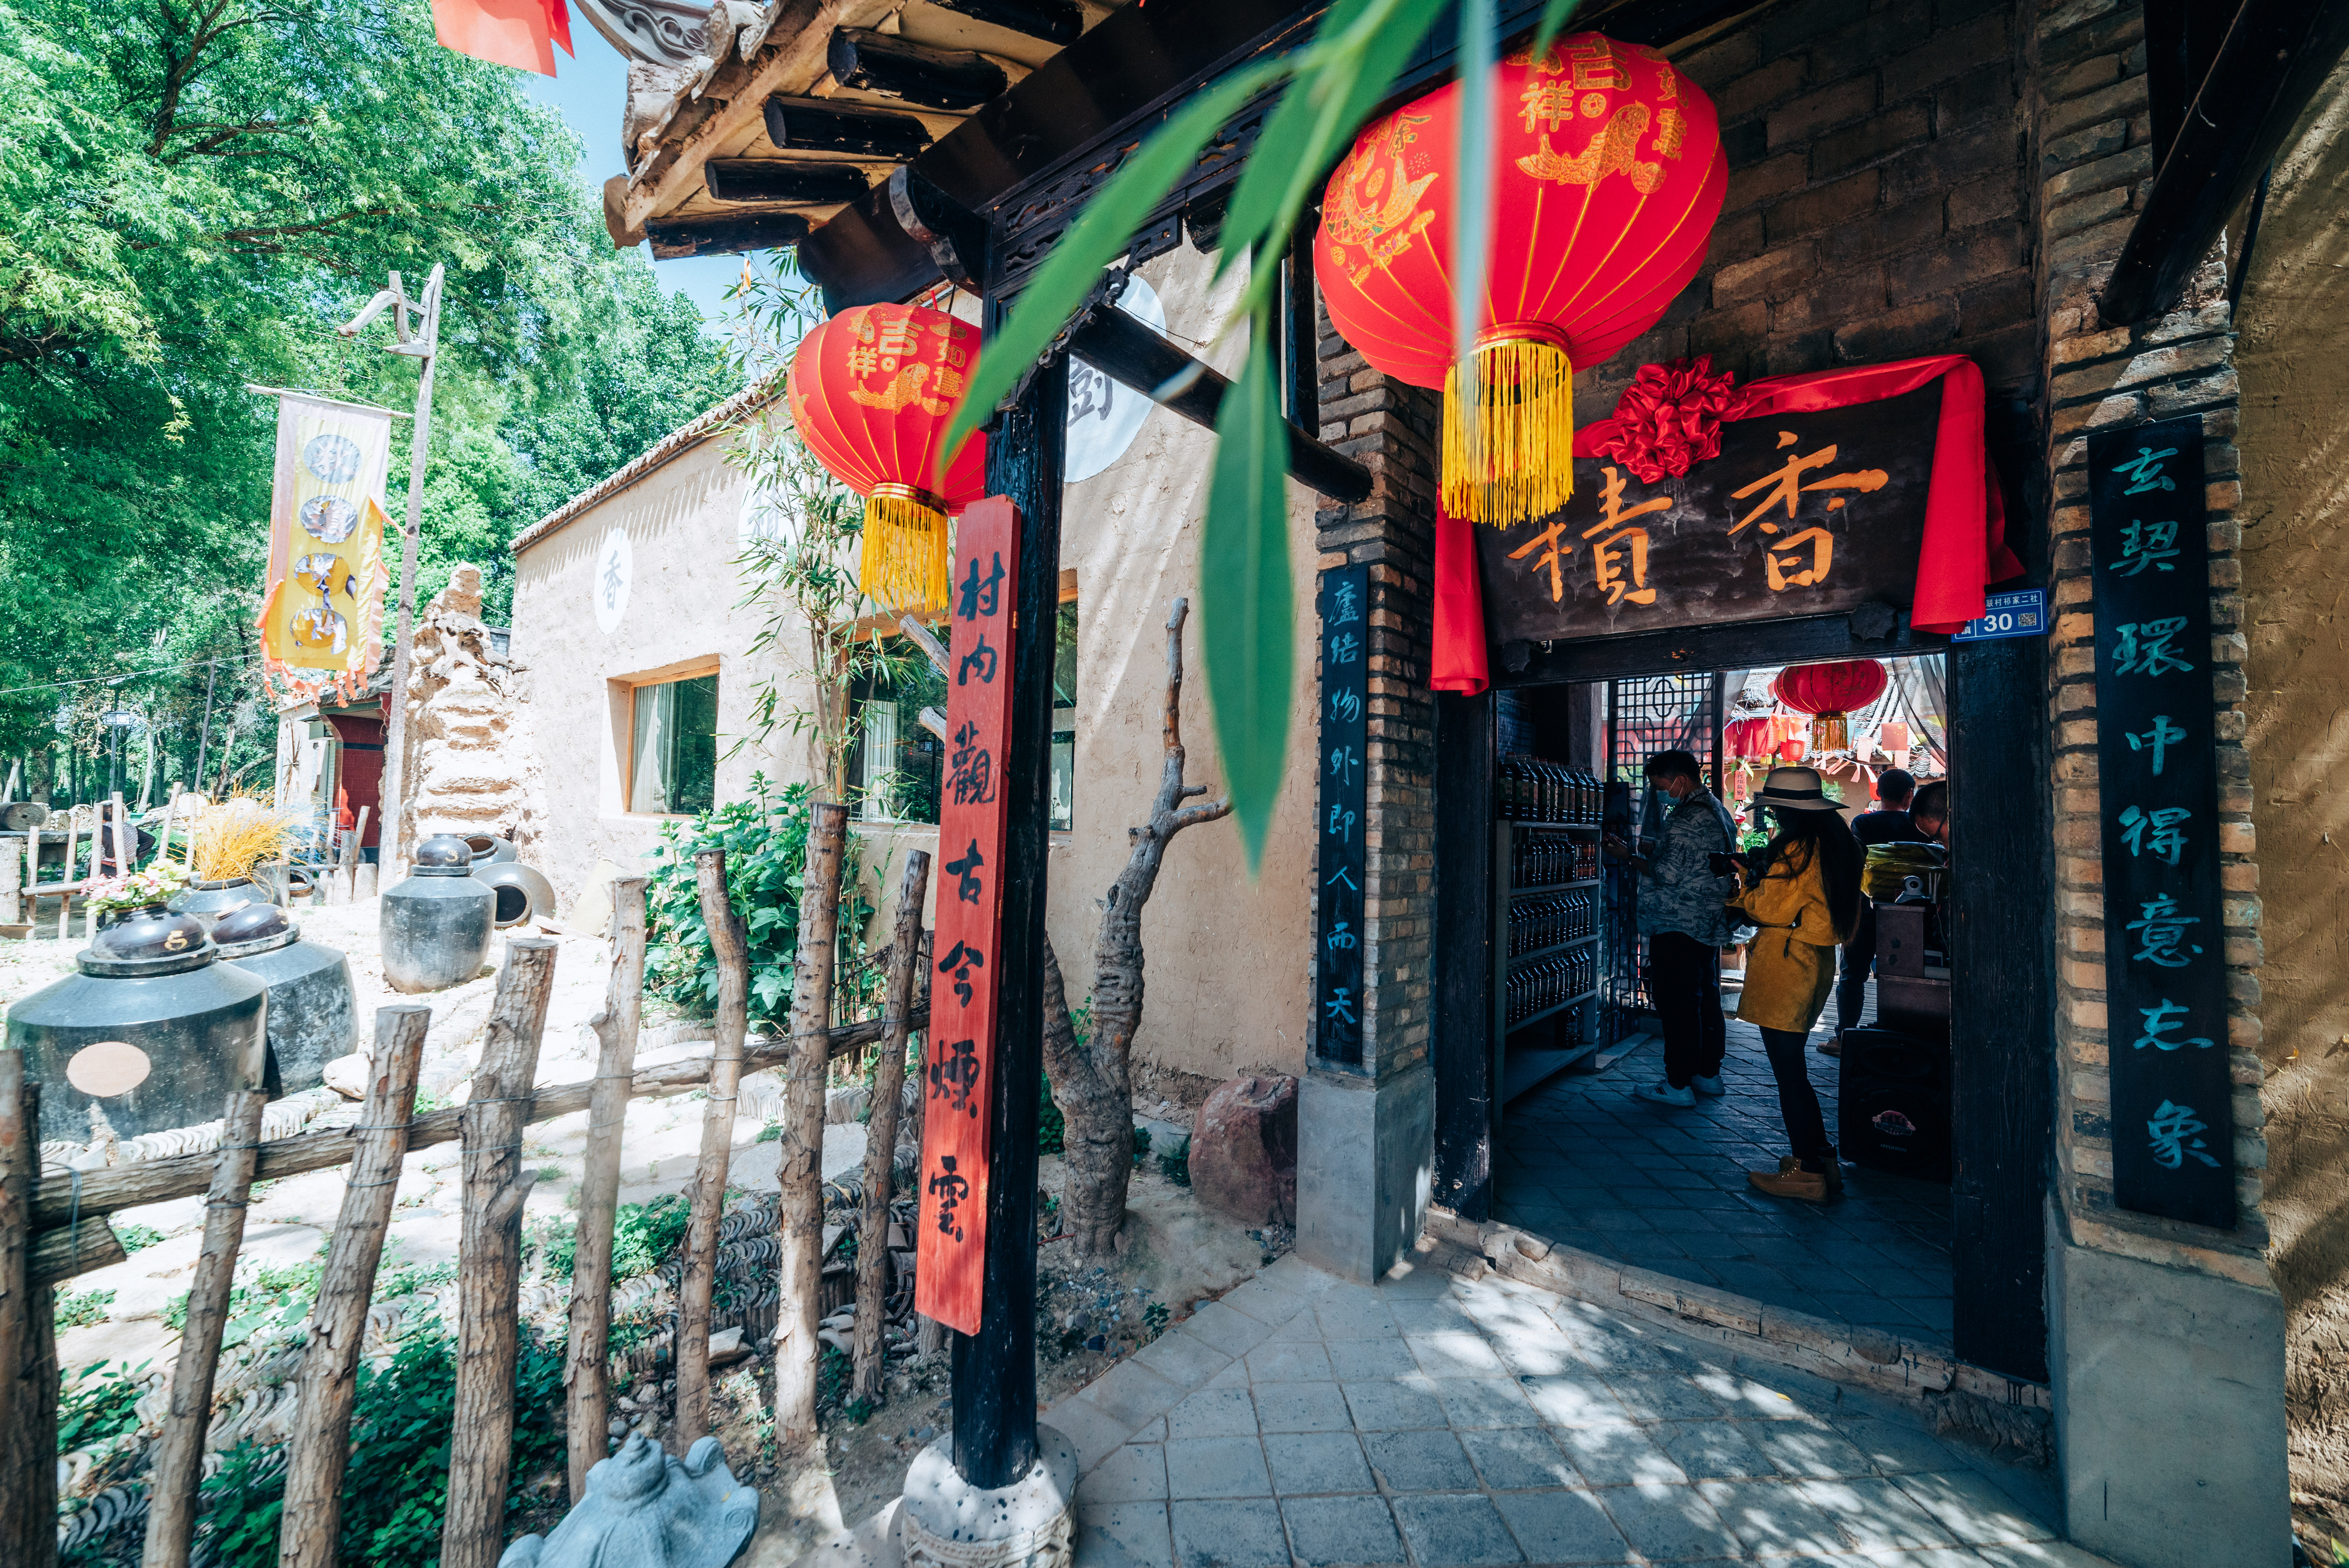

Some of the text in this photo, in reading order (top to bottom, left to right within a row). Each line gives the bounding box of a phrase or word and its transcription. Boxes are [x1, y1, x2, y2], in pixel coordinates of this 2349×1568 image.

[932, 338, 966, 398] 如意
[602, 549, 623, 610] 香
[1984, 613, 2012, 632] 30
[445, 849, 458, 862] 3
